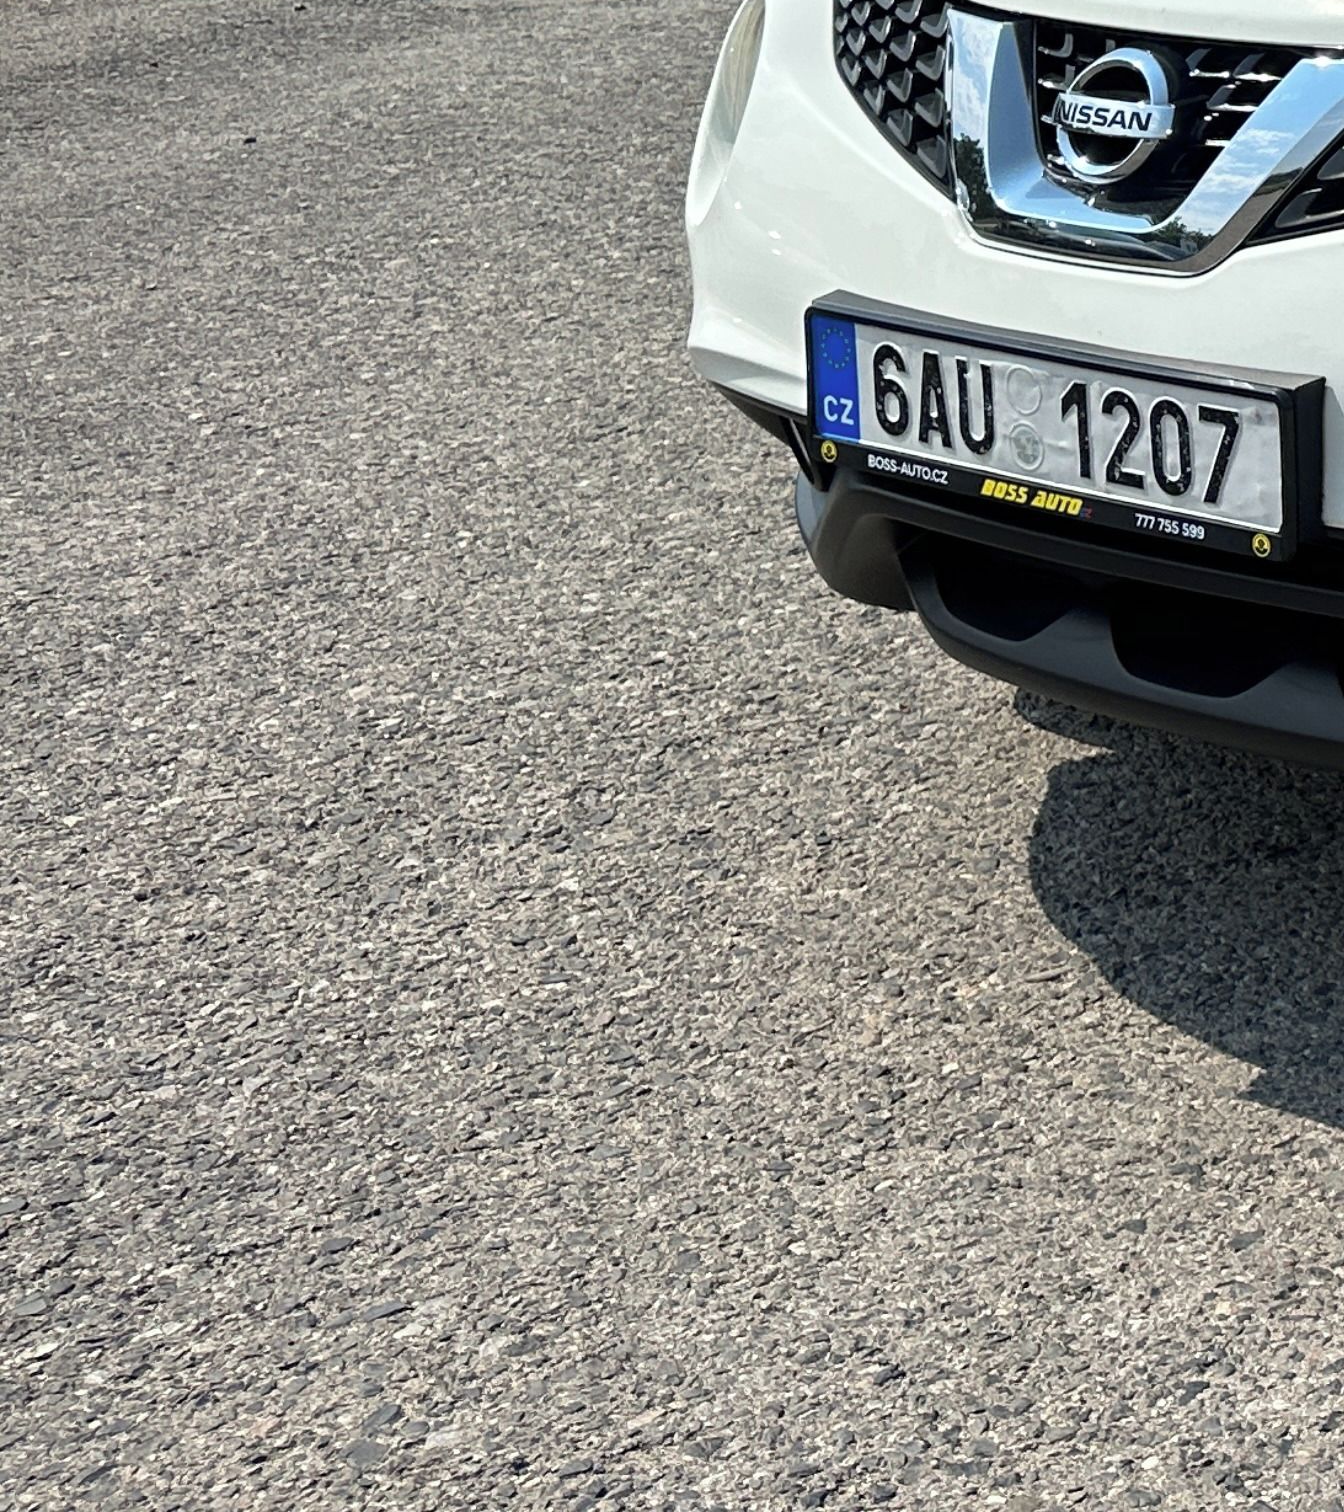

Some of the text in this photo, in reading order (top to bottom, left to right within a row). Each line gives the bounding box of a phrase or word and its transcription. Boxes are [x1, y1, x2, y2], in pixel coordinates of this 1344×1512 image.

[1054, 99, 1153, 132] NISSAN
[823, 395, 855, 425] CZ
[873, 343, 1240, 505] 6AU 1207
[867, 453, 949, 485] BOSS-AUTO.CZ
[980, 478, 1028, 504] BOSS
[1030, 491, 1084, 516] AUTO
[1135, 513, 1205, 540] 777 755 599
